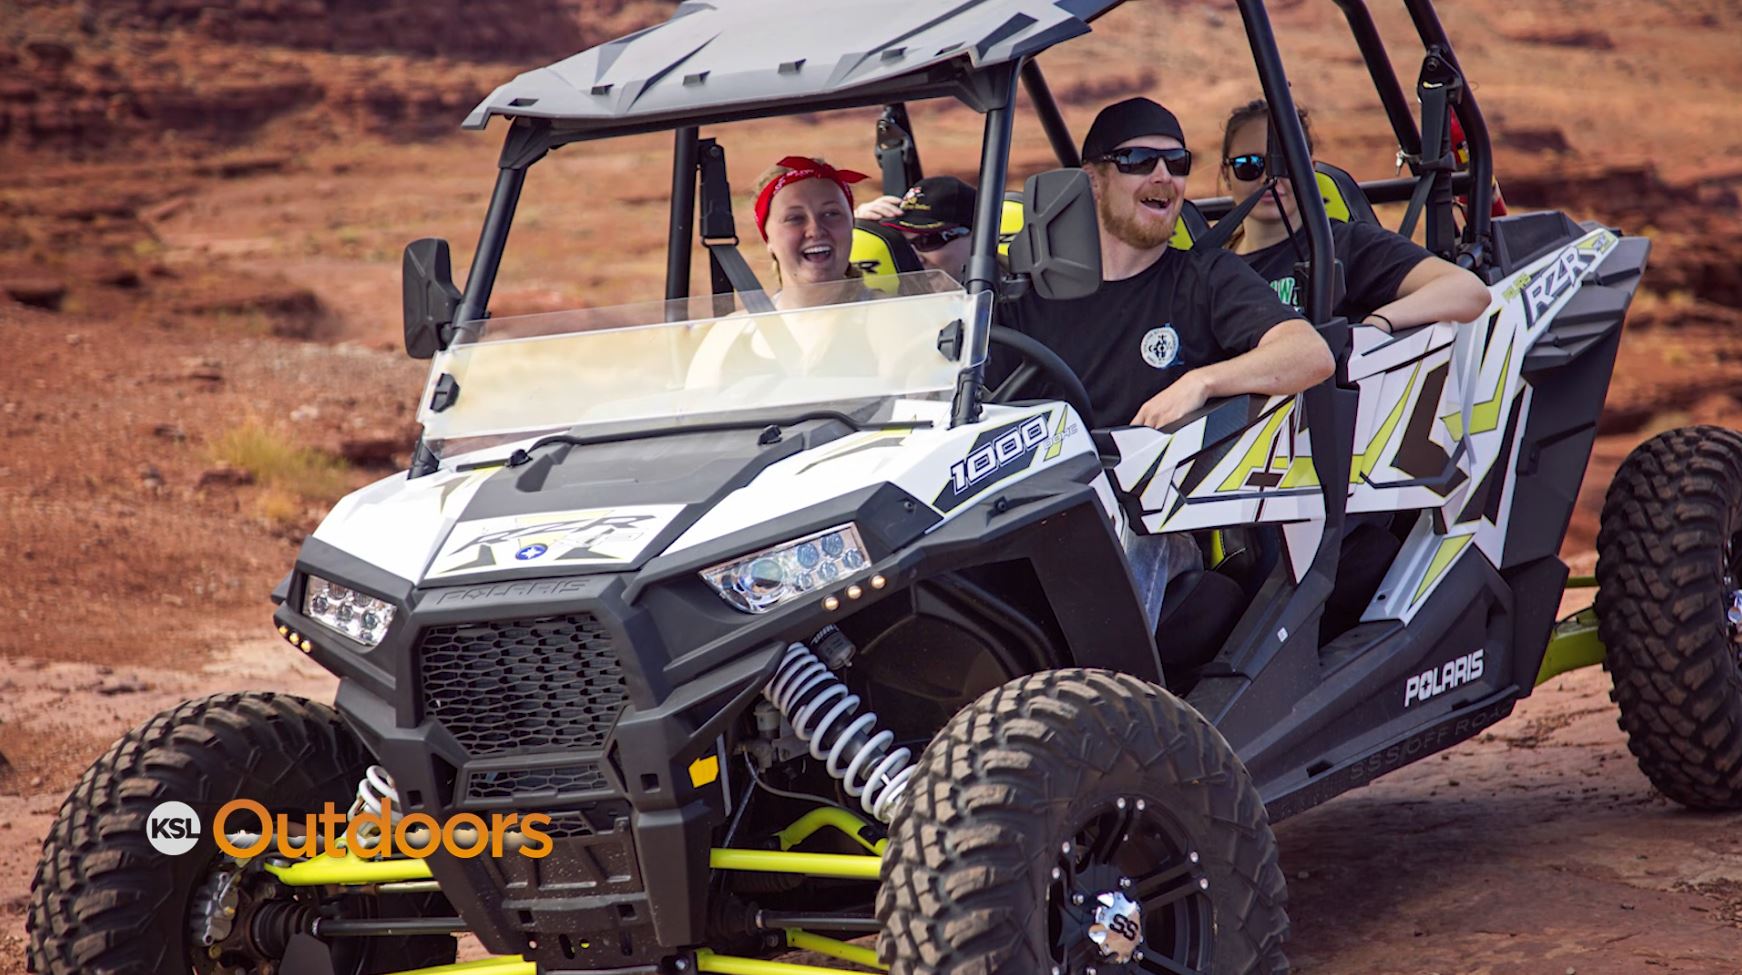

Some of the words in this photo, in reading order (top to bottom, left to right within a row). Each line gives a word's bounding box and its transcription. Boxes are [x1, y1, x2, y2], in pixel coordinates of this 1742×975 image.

[1521, 246, 1590, 330] RZR
[951, 414, 1048, 495] 1000
[437, 579, 591, 605] POLARIS
[1404, 649, 1484, 707] POLARIS
[1109, 913, 1139, 941] SS
